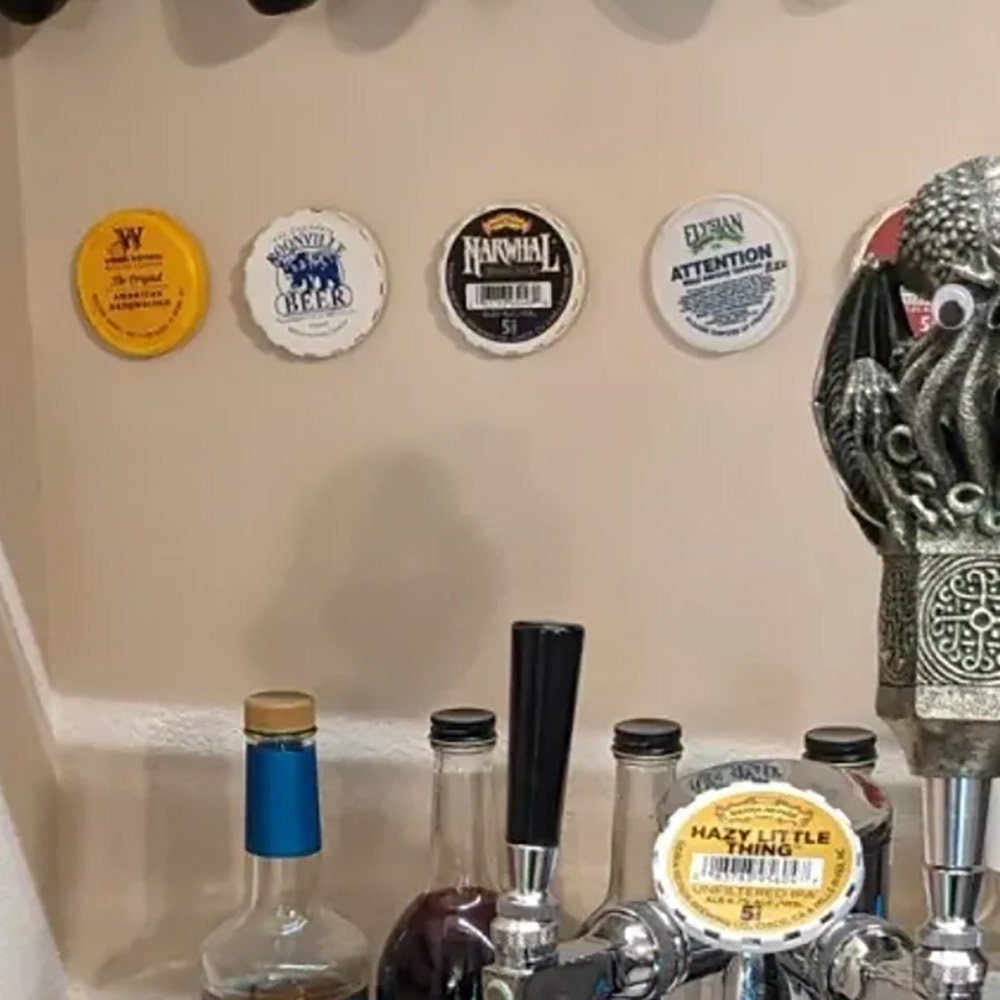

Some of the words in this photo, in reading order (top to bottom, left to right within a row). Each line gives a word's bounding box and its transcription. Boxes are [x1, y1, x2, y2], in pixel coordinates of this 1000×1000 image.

[462, 233, 561, 279] NARWHAL
[670, 243, 773, 282] ATTENTION
[285, 286, 347, 315] BEER
[690, 825, 752, 842] HAZY
[757, 829, 831, 845] LITTLE
[726, 841, 793, 858] THING
